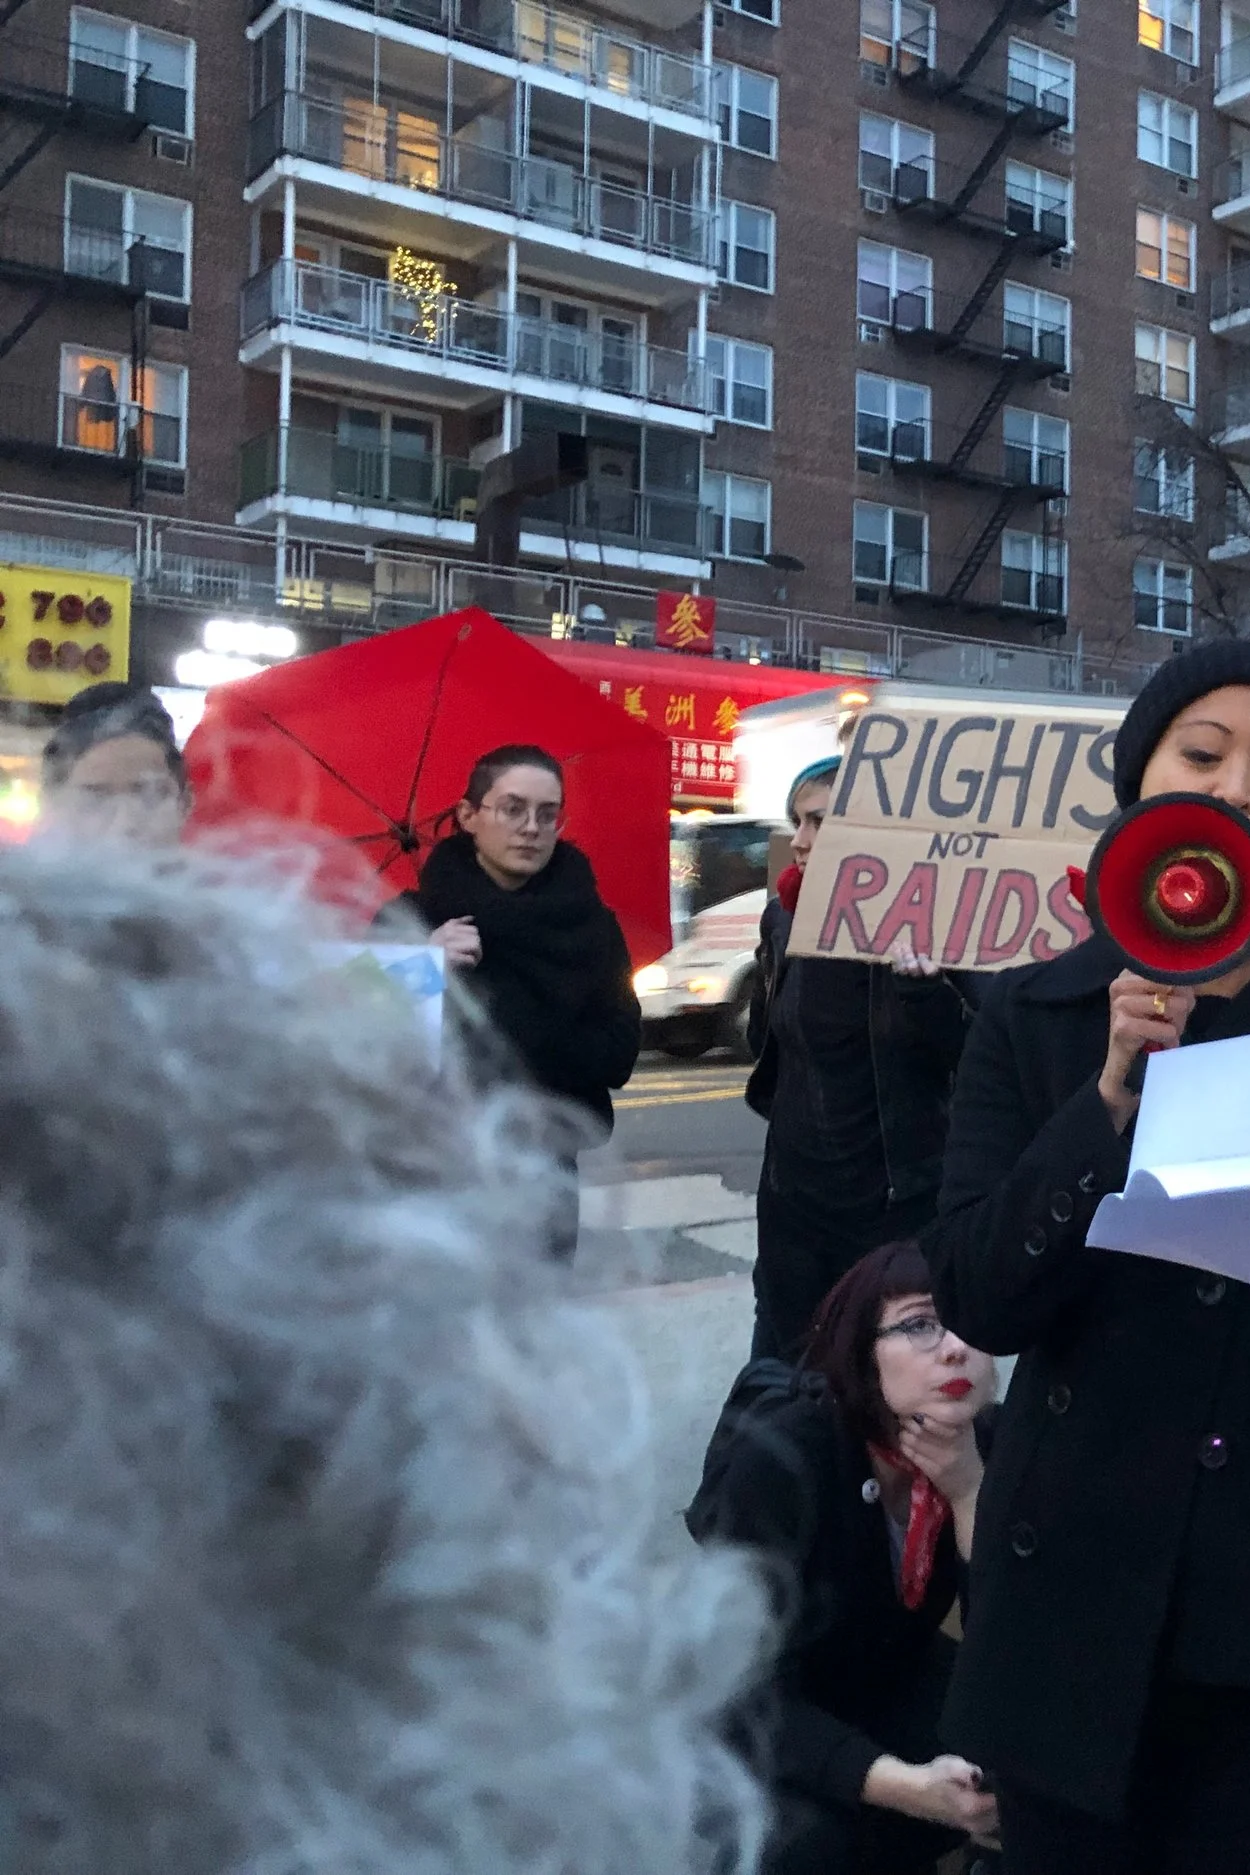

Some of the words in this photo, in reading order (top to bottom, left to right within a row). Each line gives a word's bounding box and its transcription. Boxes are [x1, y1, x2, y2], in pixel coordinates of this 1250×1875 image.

[832, 713, 1122, 832] RIGHTS
[927, 831, 1000, 860] NOT
[817, 853, 1095, 966] RAIDS
